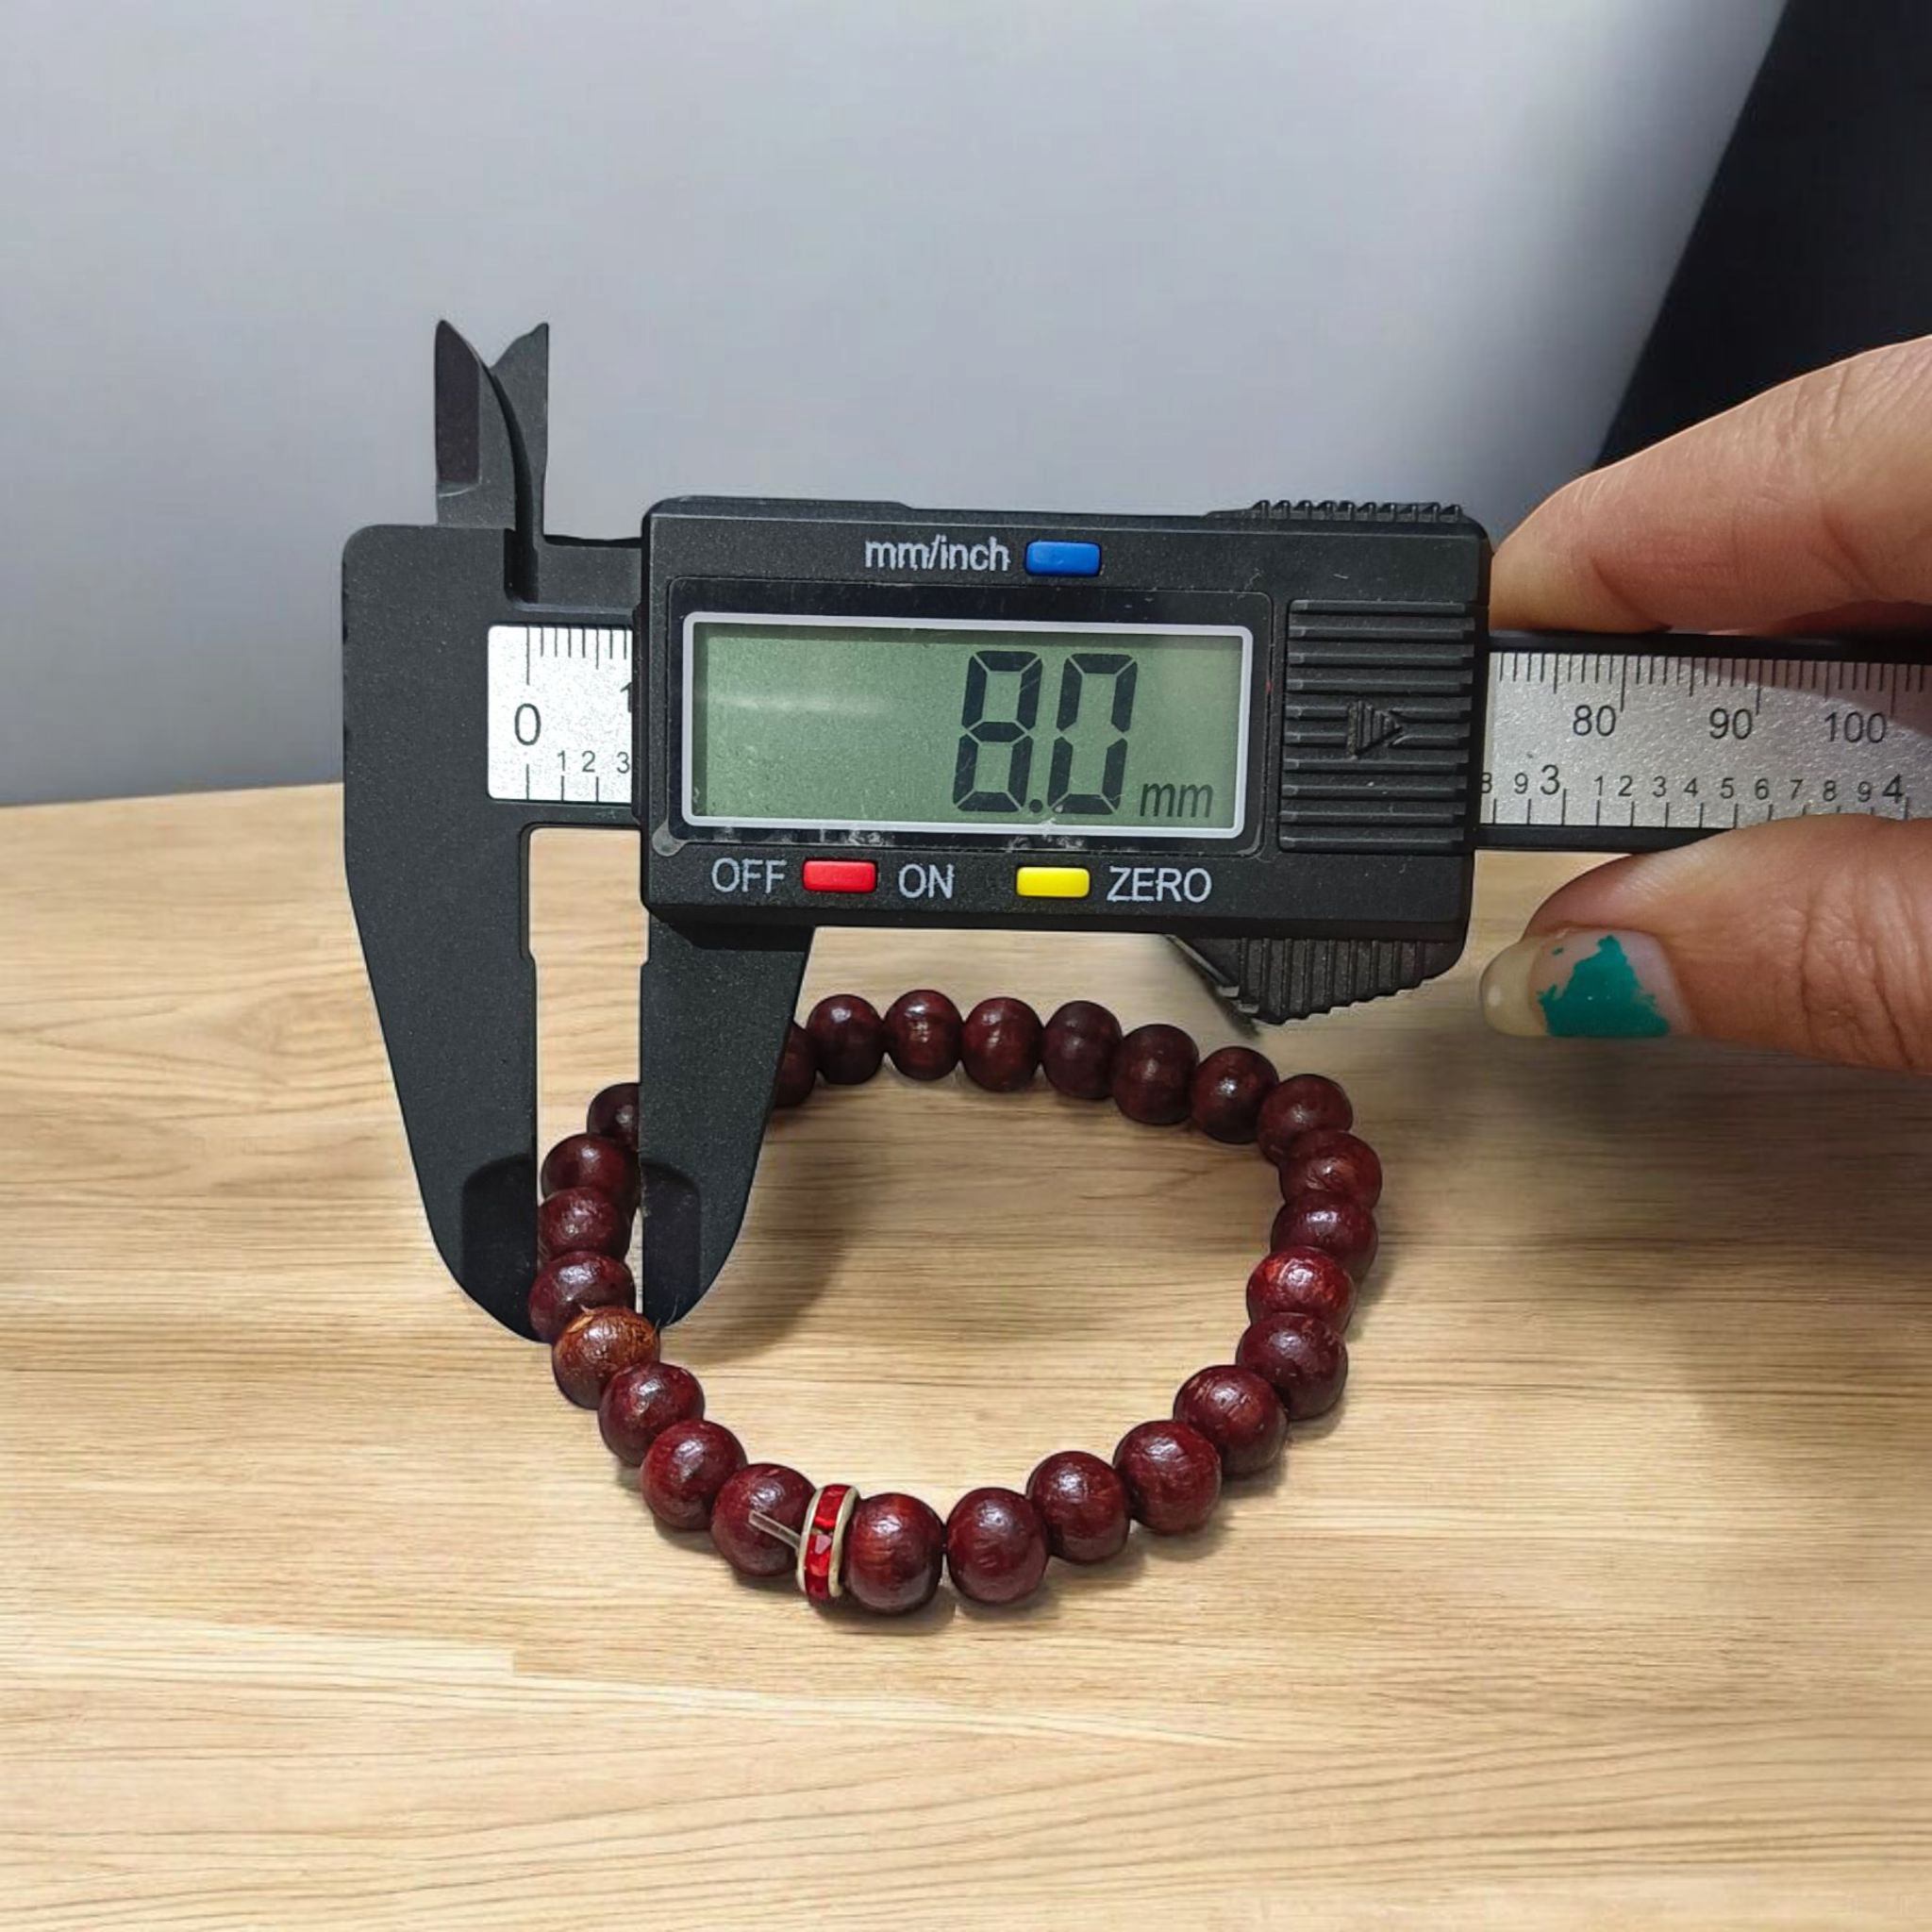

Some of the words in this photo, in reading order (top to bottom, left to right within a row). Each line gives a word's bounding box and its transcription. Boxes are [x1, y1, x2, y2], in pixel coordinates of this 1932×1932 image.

[864, 534, 1010, 572] mm/inch
[620, 682, 632, 713] 1
[514, 703, 541, 745] 0
[952, 650, 1138, 816] 8.0
[1139, 781, 1214, 819] mm
[1573, 705, 1617, 737] 80
[1709, 708, 1753, 740] 90
[1824, 711, 1886, 743] 100
[557, 750, 566, 772] 1
[581, 750, 595, 773] 2
[616, 751, 630, 774] 3
[1514, 773, 1528, 794] 9
[1540, 764, 1560, 795] 3
[1593, 775, 1603, 796] 1
[1618, 774, 1633, 797] 2
[1652, 775, 1667, 798] 3
[1683, 777, 1698, 798] 4
[1720, 777, 1734, 799] 5
[1755, 778, 1770, 800] 6
[1790, 779, 1803, 800] 7
[1823, 780, 1837, 802] 8
[1857, 781, 1872, 803] 9
[1882, 774, 1905, 804] 4
[710, 858, 787, 894] OFF
[897, 863, 955, 899] ON
[1106, 866, 1212, 903] ZERO
